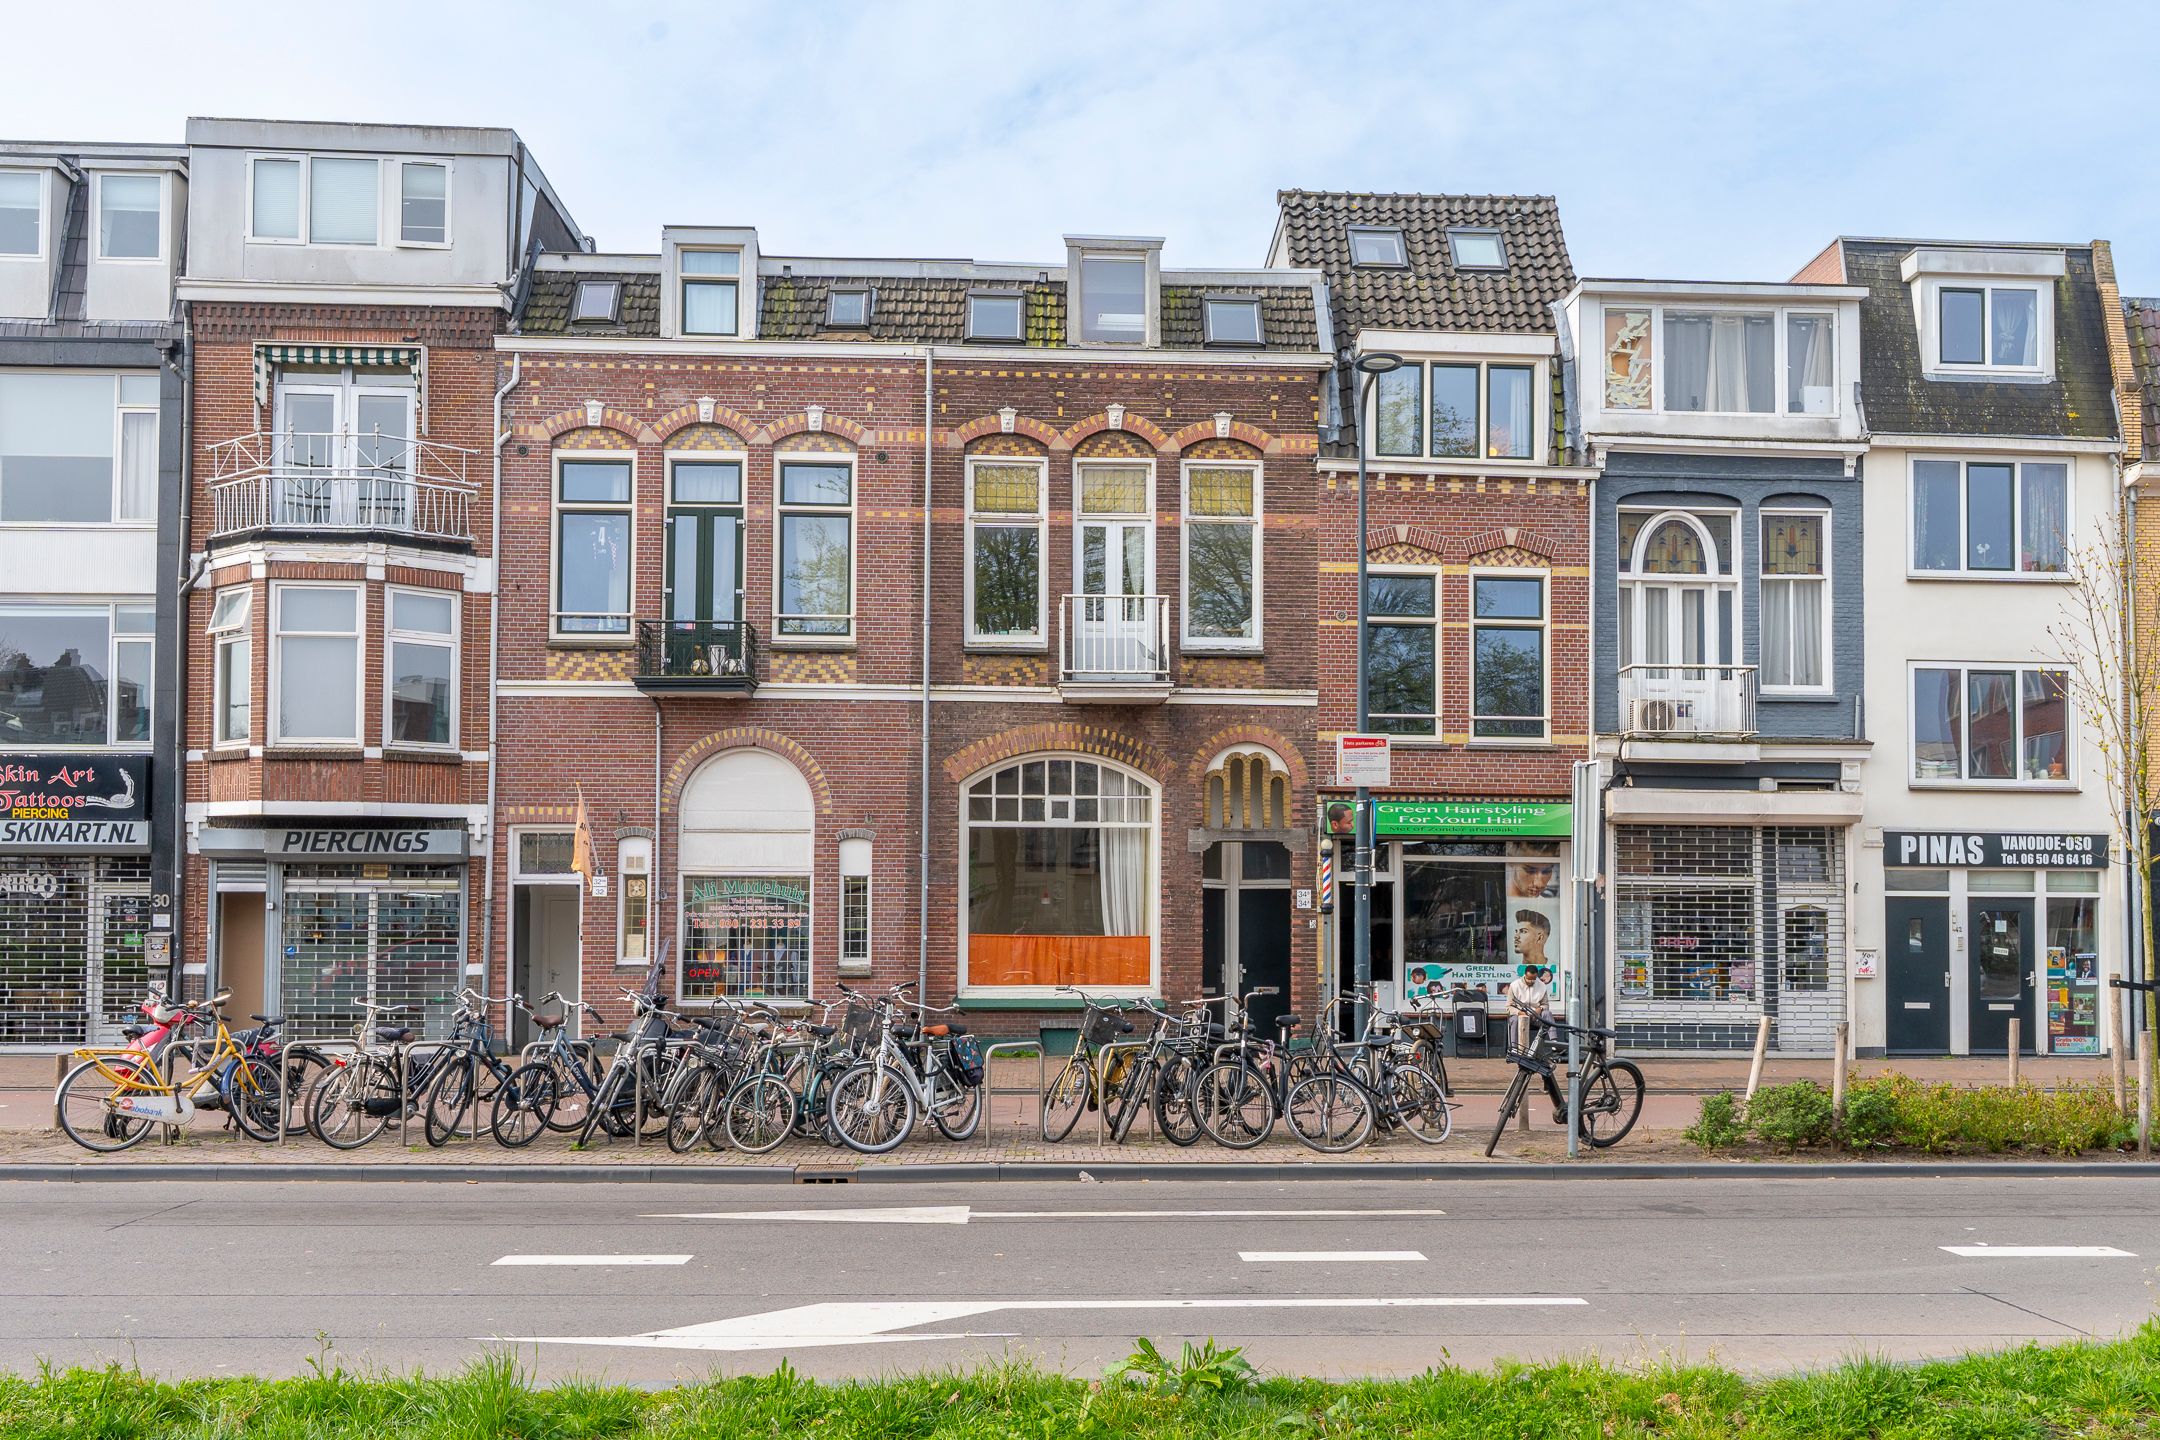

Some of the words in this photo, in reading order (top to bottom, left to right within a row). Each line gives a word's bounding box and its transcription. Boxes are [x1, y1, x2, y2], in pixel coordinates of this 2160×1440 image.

[48, 765, 95, 788] Art
[12, 807, 69, 819] PIERCING
[1378, 805, 1438, 813] Green
[1445, 805, 1546, 816] Hairstyling
[1399, 816, 1431, 824] For
[1435, 816, 1480, 824] Your
[1487, 816, 1526, 824] Hair
[2, 822, 137, 843] SKINART.NL
[282, 831, 430, 853] PIERCINGS
[2001, 836, 2093, 851] VANODOE-OSO
[1900, 835, 1984, 865] PINAS
[2001, 853, 2020, 865] Tel.
[2021, 854, 2034, 865] 06
[2036, 854, 2049, 865] 50
[2051, 854, 2064, 865] 46
[2066, 854, 2079, 865] 64
[2080, 854, 2093, 866] 16
[692, 881, 717, 901] Ali
[721, 879, 806, 901] Modehuis
[152, 894, 170, 908] 30
[719, 919, 739, 929] 030
[750, 919, 768, 929] 231
[771, 919, 784, 928] 33
[688, 967, 721, 978] OPEN
[1476, 971, 1512, 979] STYLING
[128, 1104, 163, 1117] abobank
